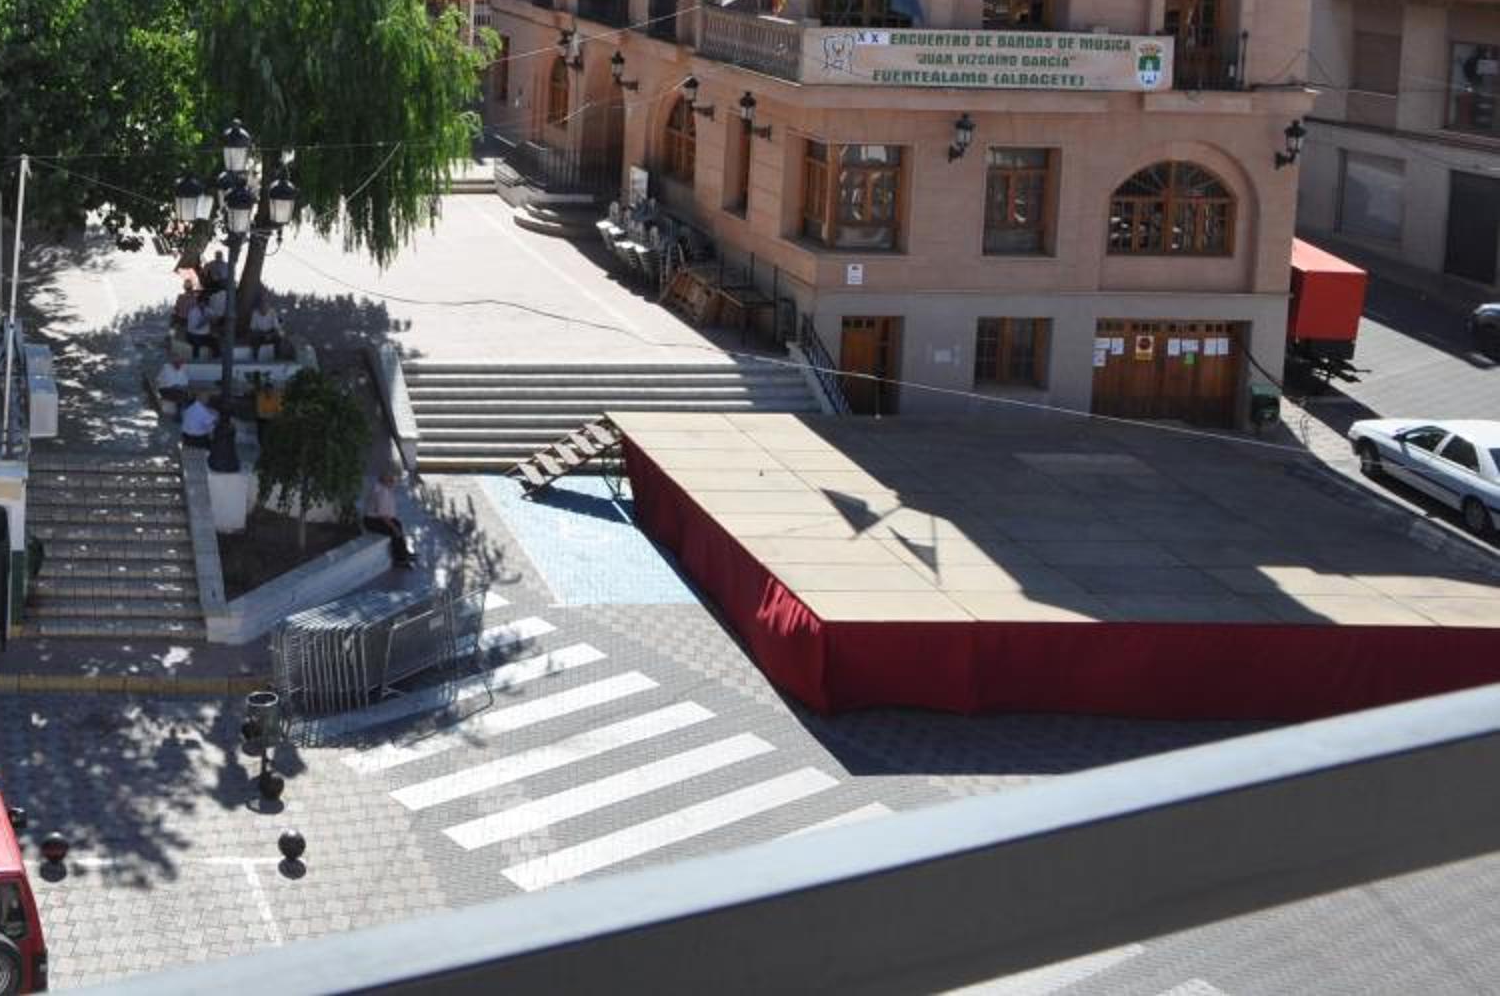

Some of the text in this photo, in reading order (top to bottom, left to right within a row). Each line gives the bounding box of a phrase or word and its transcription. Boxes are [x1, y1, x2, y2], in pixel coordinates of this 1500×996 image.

[890, 32, 970, 46] ENCUENTRO
[975, 34, 993, 46] DE
[997, 35, 1055, 50] BANDAS
[1058, 37, 1075, 50] DE
[993, 72, 1085, 86] (ALBACETE)
